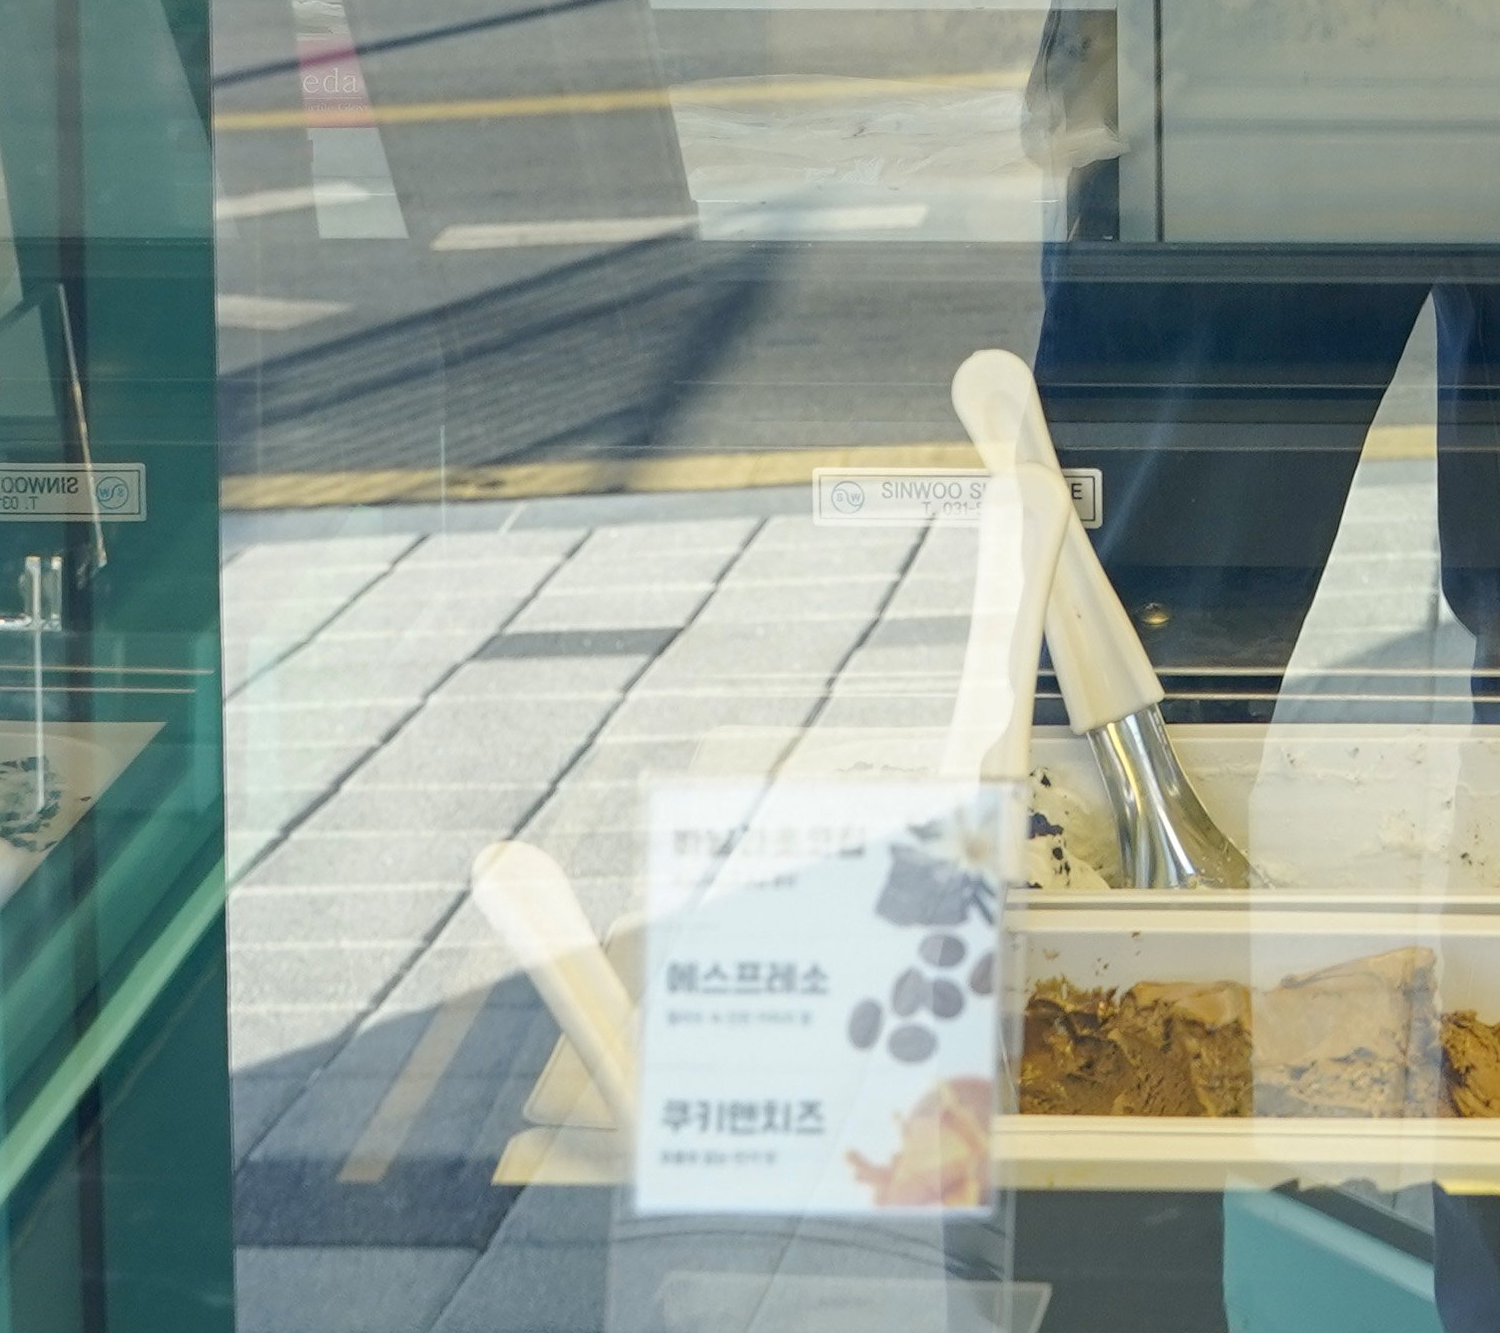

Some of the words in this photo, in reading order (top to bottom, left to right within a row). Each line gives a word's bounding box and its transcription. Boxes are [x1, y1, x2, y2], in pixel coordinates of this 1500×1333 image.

[881, 482, 962, 499] SINWOO
[665, 961, 830, 995] 에스프레소
[661, 1098, 826, 1134] 쿠키앤치즈
